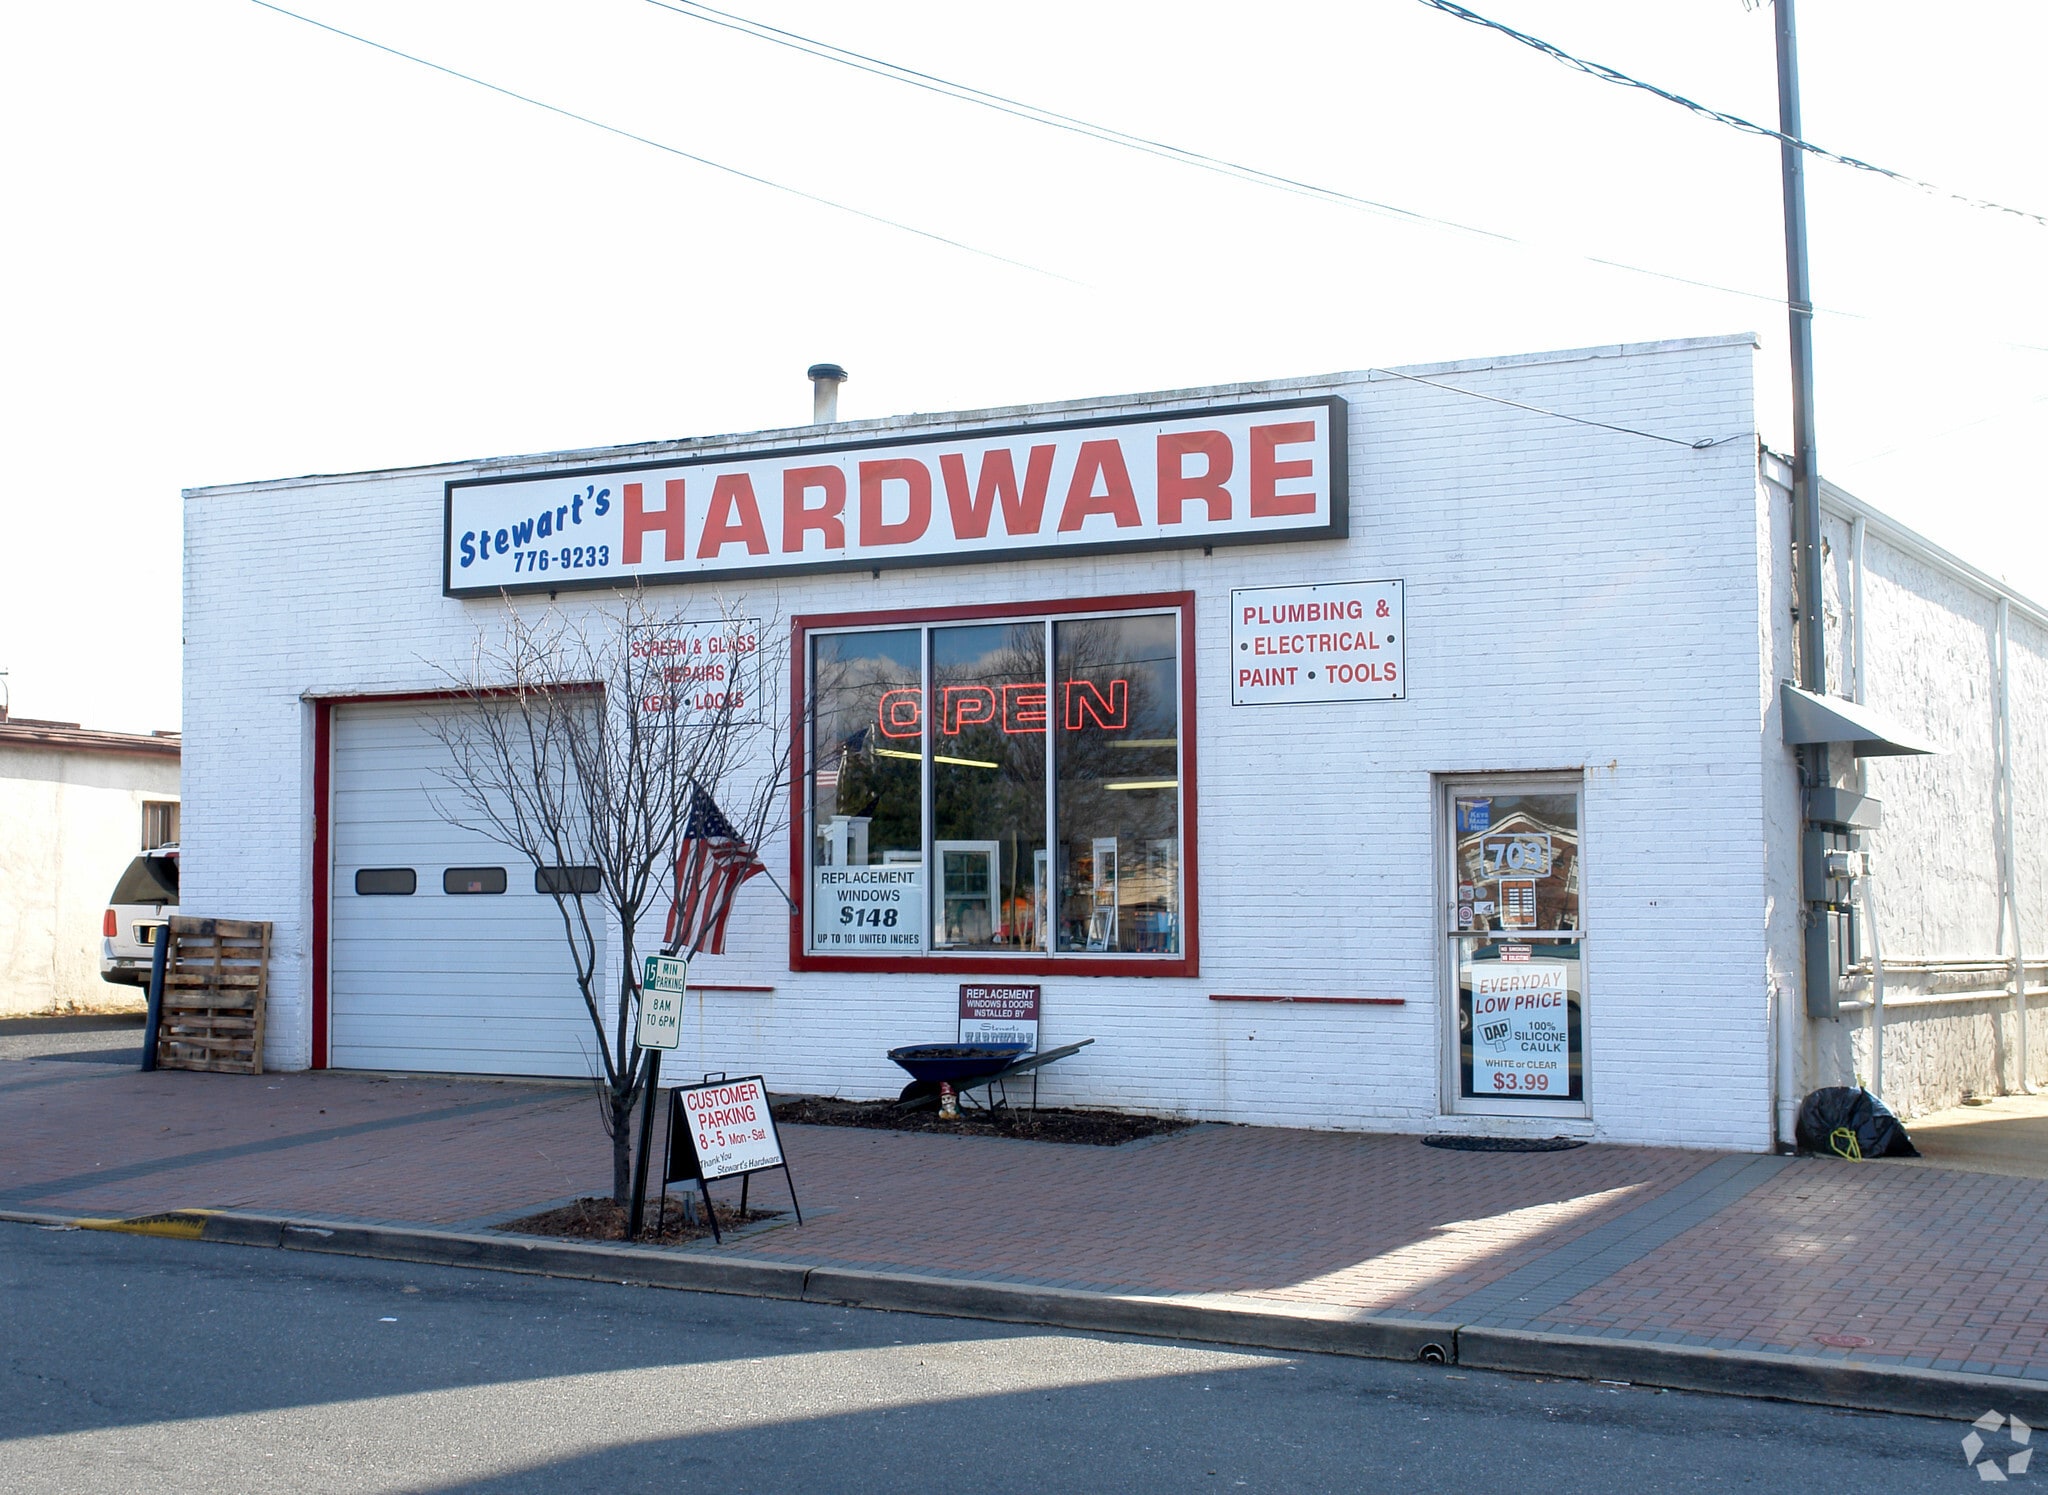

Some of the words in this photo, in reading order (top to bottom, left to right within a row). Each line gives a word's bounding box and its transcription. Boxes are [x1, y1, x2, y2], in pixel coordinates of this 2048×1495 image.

[621, 420, 1318, 565] HARDWARE
[460, 485, 611, 568] Stewart's
[514, 545, 609, 573] 776-9233
[1243, 600, 1362, 625] PLUMBING
[1375, 599, 1390, 618] &
[632, 640, 686, 658] SCREEN
[693, 638, 702, 654] &
[709, 635, 755, 653] GLASS
[1254, 631, 1380, 655] ELECTRICAL
[664, 664, 725, 683] REPAIRS
[1239, 667, 1298, 687] PAINT
[1325, 662, 1397, 683] TOOLS
[879, 679, 1128, 738] OPEN
[1488, 842, 1542, 870] 703
[821, 872, 914, 884] REPLACEMENT
[837, 890, 900, 901] WINDOWS
[840, 906, 898, 927] $148
[818, 934, 827, 943] UP
[831, 934, 840, 943] TO
[844, 934, 855, 943] 101
[859, 934, 886, 944] UNITED
[891, 934, 919, 944] INCHES
[646, 964, 656, 981] 15
[663, 963, 678, 975] MIN
[657, 976, 682, 989] PARKING
[1480, 972, 1562, 994] EVERYDAY
[966, 989, 1034, 999] REPLACEMENT
[1476, 997, 1510, 1014] LOW
[1515, 992, 1562, 1010] PRICE
[967, 1000, 1001, 1008] WINDOWS
[974, 1009, 1012, 1017] INSTALLED
[646, 1014, 656, 1025] TO
[1529, 1022, 1556, 1031] 100%
[1484, 1022, 1508, 1040] DAP
[1514, 1031, 1566, 1042] SILICONE
[1521, 1042, 1561, 1052] CAULK
[1527, 1061, 1557, 1069] CLEAR
[1493, 1071, 1548, 1091] $3.99
[687, 1083, 759, 1111] CUSTOMER
[698, 1105, 757, 1131] PARKING
[717, 1161, 748, 1174] Stewart's
[748, 1155, 780, 1168] Hardware
[720, 1152, 732, 1162] You
